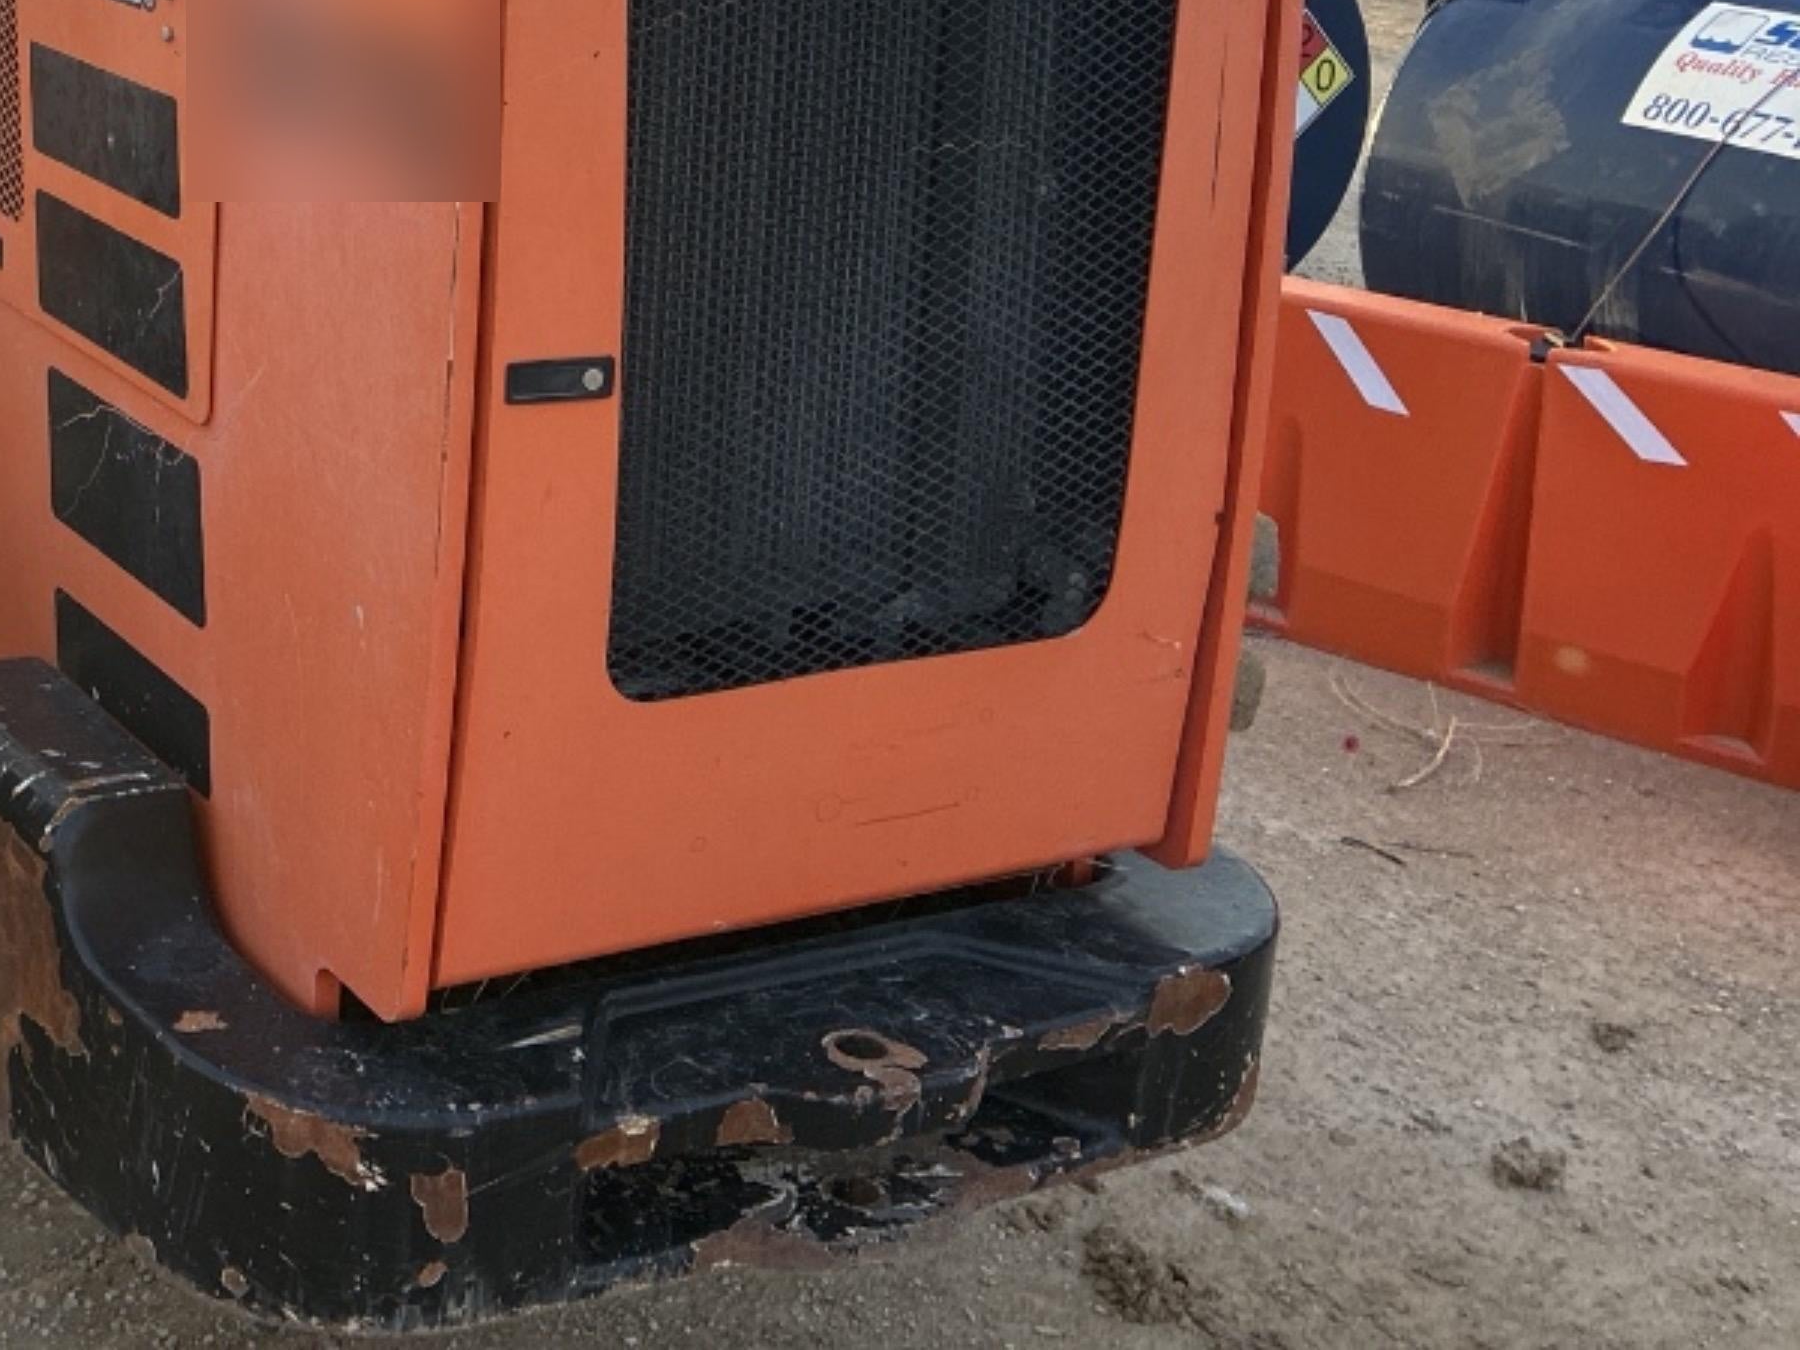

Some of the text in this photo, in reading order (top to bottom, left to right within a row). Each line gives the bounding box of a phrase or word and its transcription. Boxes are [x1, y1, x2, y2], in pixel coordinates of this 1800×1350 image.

[1315, 57, 1337, 93] 0
[1675, 51, 1763, 85] Quality
[1643, 93, 1800, 149] 800-677-
